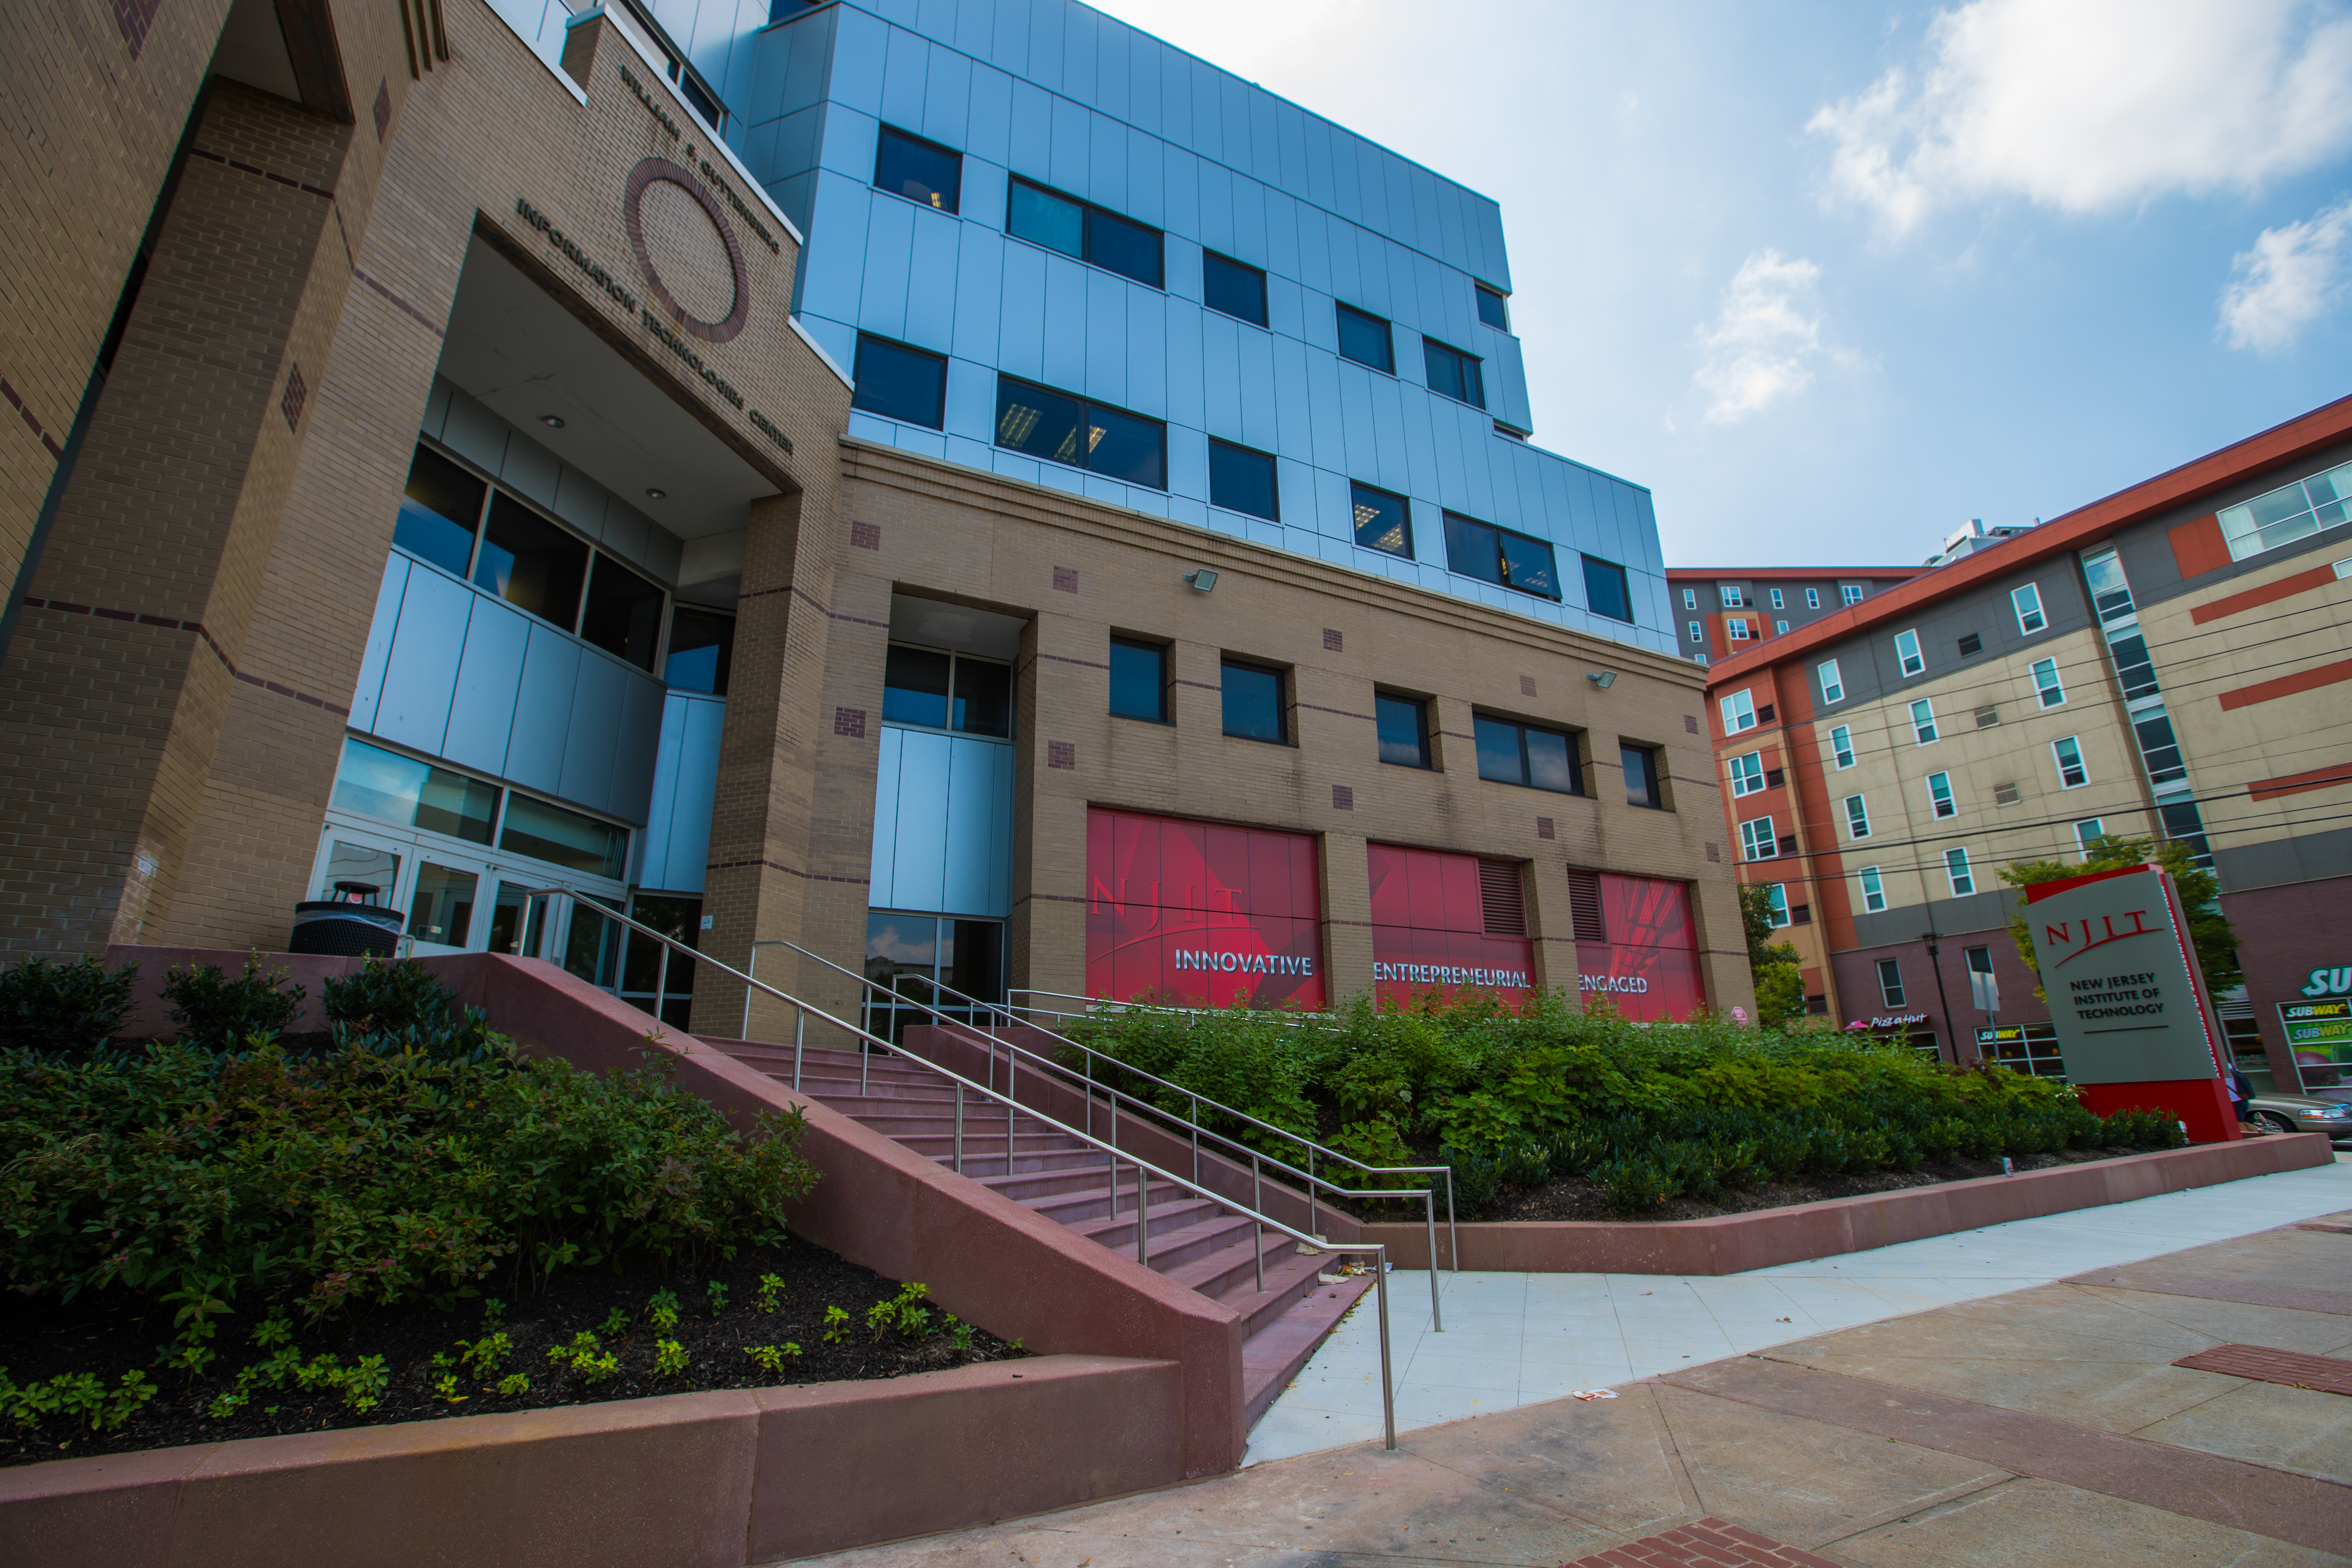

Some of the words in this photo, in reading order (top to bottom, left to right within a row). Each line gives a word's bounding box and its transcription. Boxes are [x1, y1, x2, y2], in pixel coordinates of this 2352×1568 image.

[622, 64, 680, 141] WILLIAM
[701, 160, 779, 254] GUTTENBERG
[517, 198, 636, 313] INFORMATION
[641, 308, 744, 410] TECHNOLOGIES
[749, 409, 793, 456] CENTER
[1090, 875, 1243, 931] NJIT
[2046, 910, 2147, 946] NJIT
[1176, 949, 1313, 976] INNOVATIVE
[1374, 962, 1531, 988] ENTREPRENEURIAL
[1578, 974, 1648, 993] ENGAGED
[2070, 978, 2103, 991] NEW
[2107, 972, 2155, 989] JERSEY
[2074, 990, 2139, 1005] INSTITUTE
[2142, 988, 2160, 999] OF
[2076, 1003, 2163, 1020] TECHNOLOGY
[2285, 1003, 2347, 1017] SUBWAY
[2291, 1023, 2352, 1040] SUBWAY
